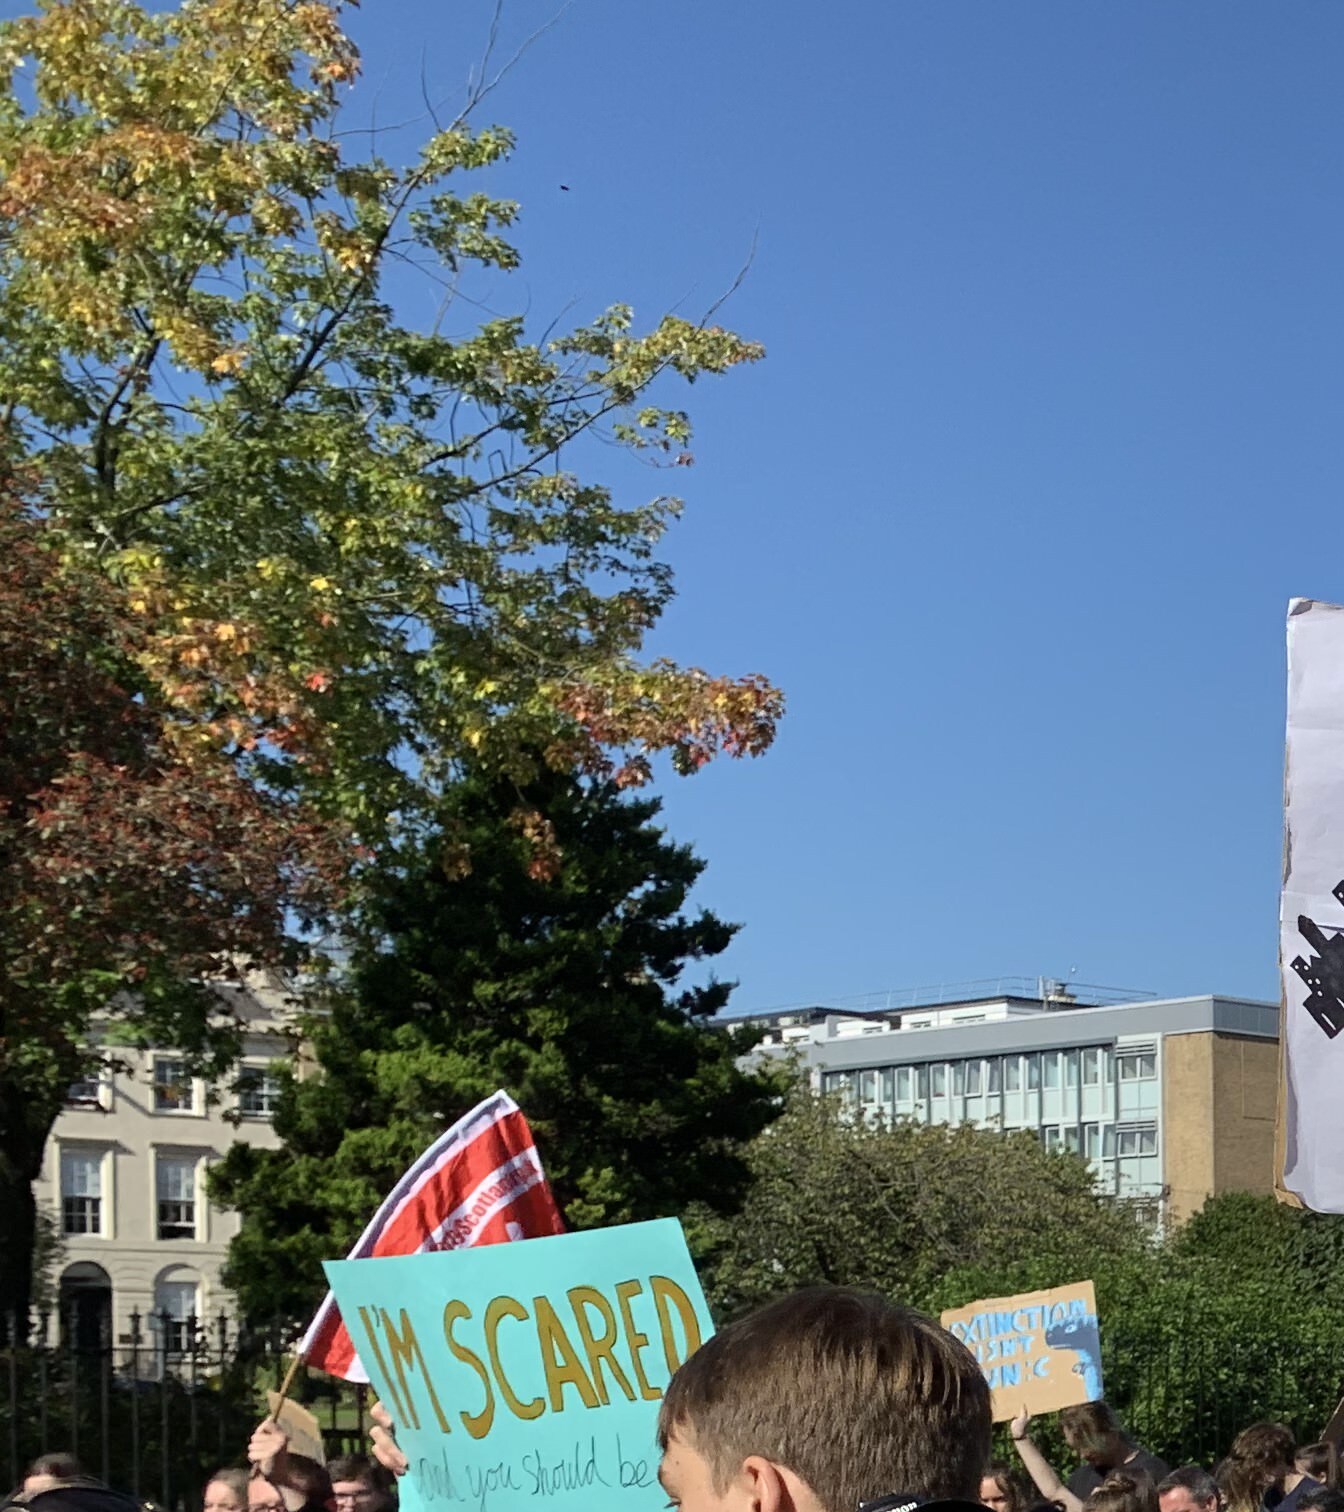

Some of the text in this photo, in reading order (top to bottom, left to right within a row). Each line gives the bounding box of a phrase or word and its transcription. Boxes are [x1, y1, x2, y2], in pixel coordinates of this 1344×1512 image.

[357, 1275, 702, 1440] I'M SCARED
[521, 1434, 613, 1496] should
[616, 1432, 656, 1489] be
